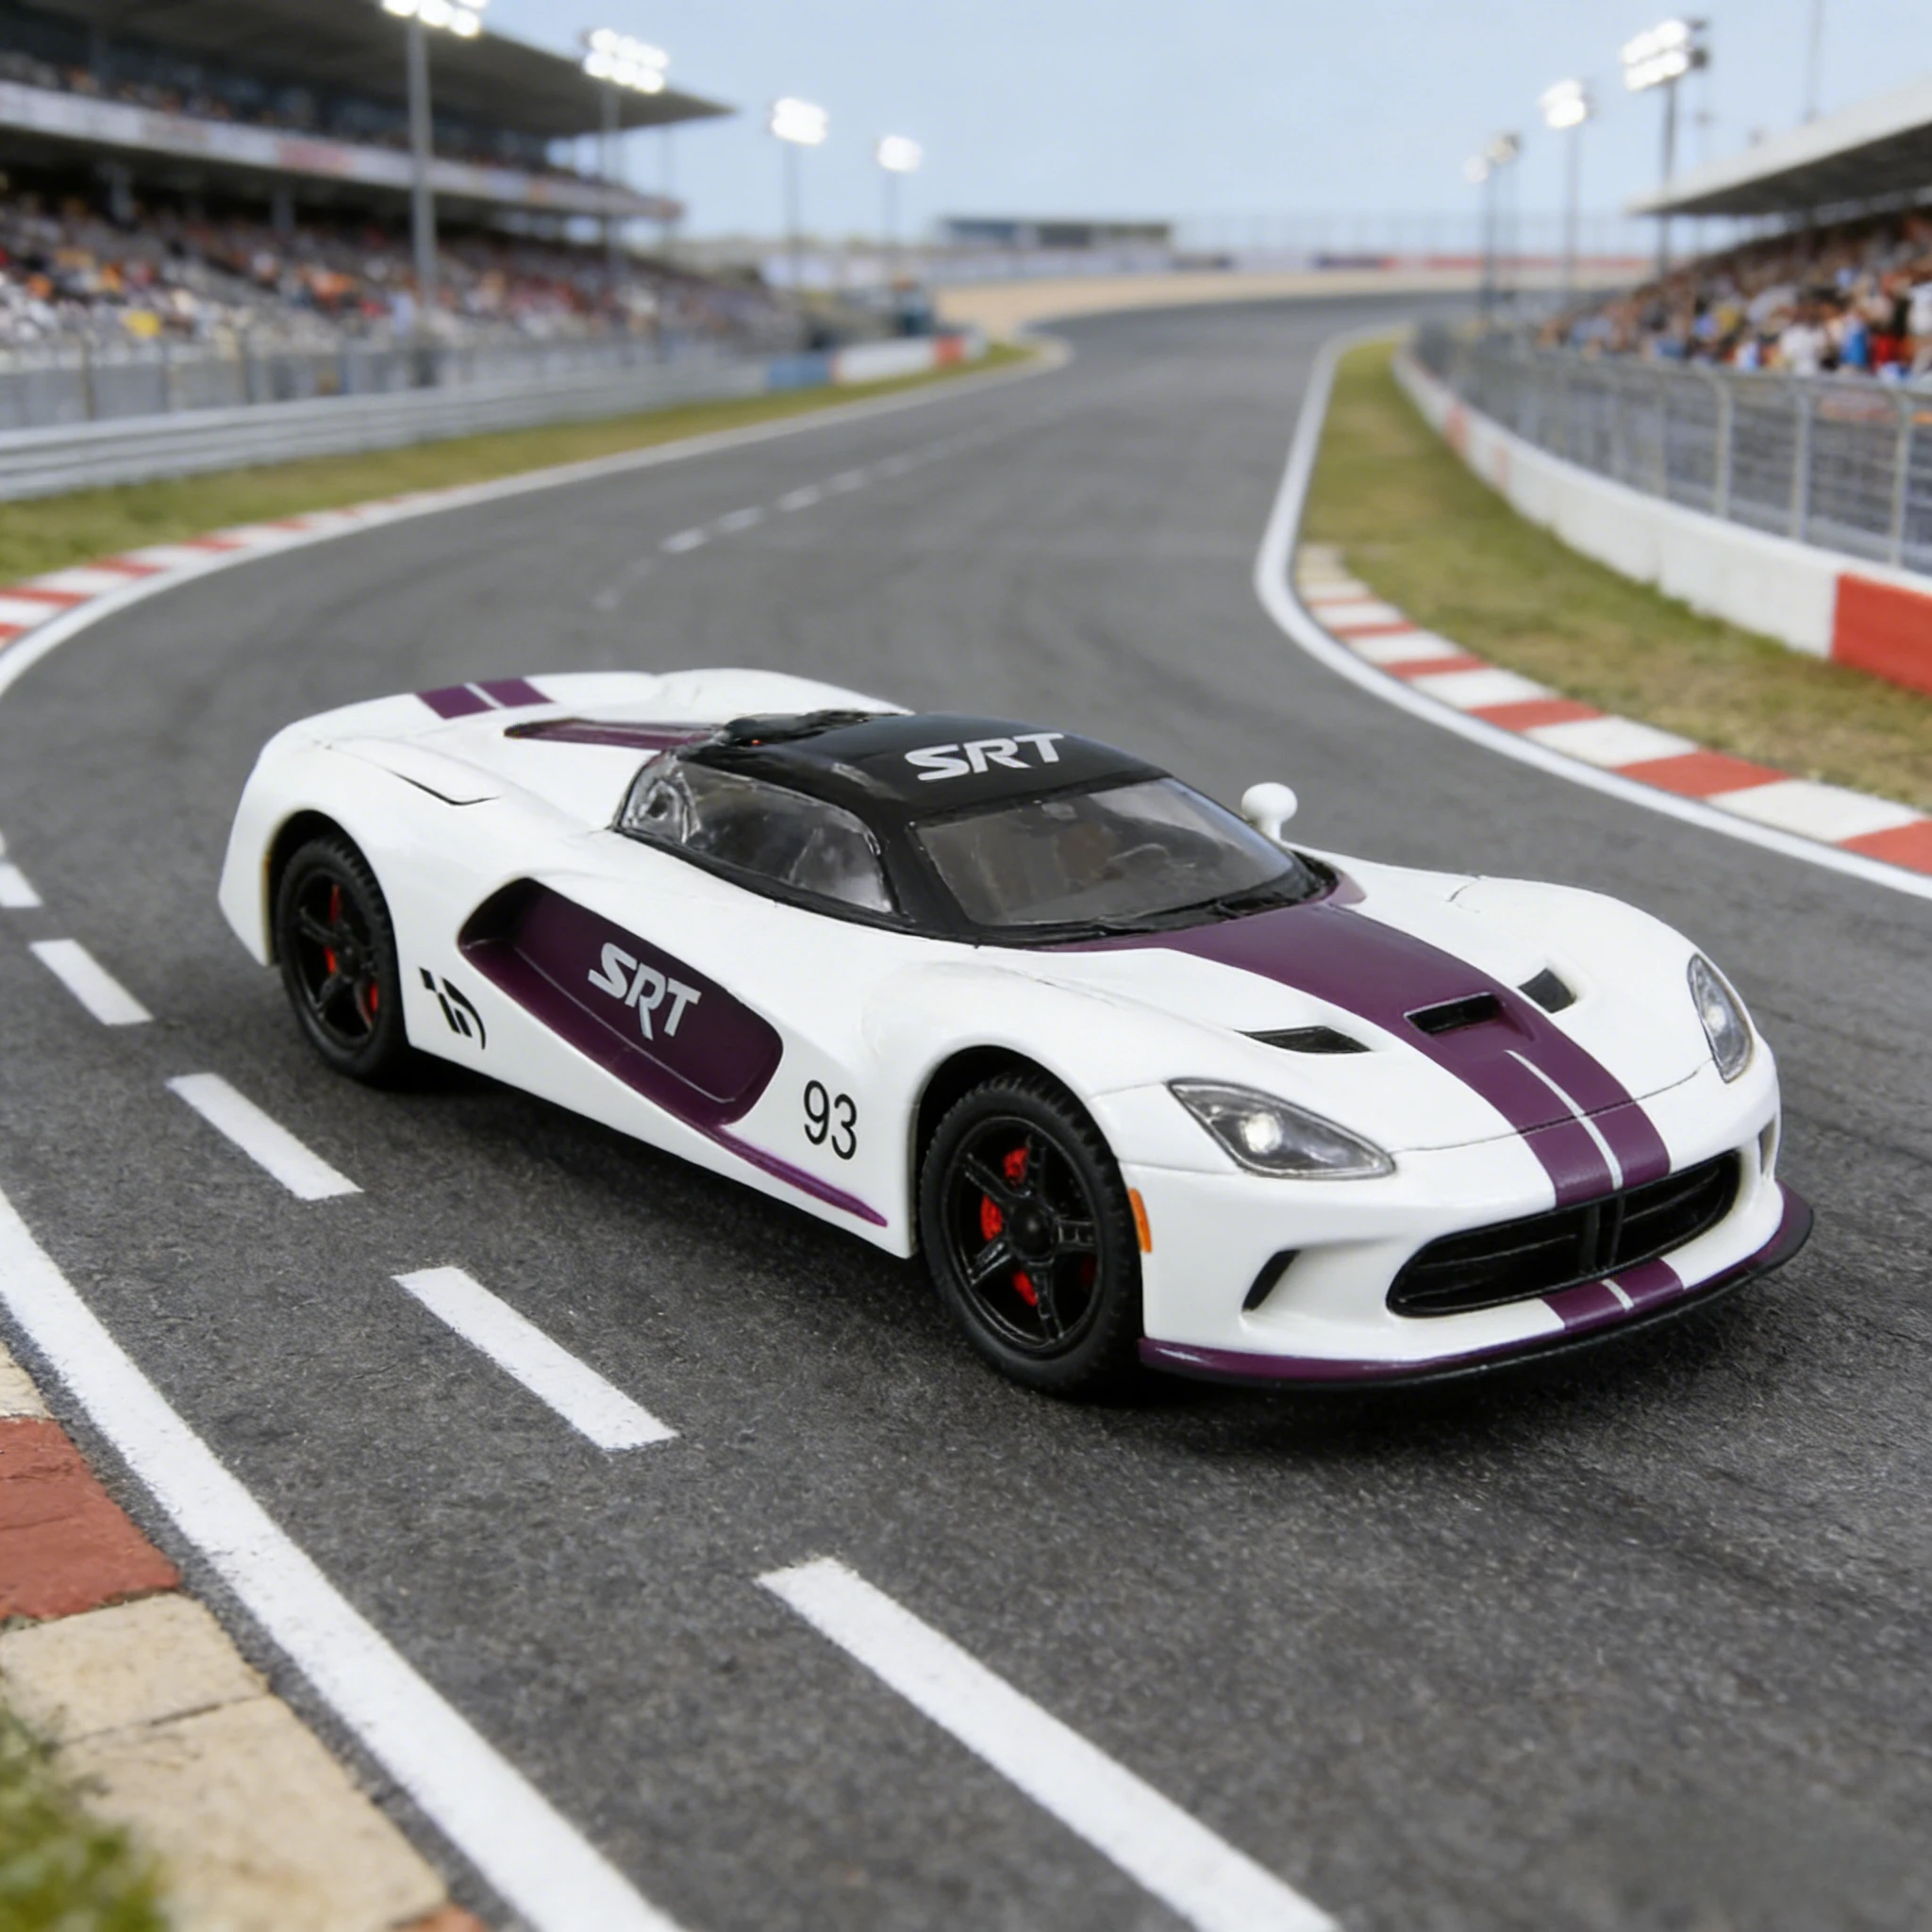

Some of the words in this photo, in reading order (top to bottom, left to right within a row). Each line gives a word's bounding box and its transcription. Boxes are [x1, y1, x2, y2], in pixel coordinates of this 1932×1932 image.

[905, 732, 1064, 781] SRT
[588, 942, 702, 1040] SRT
[804, 1080, 858, 1159] 93
